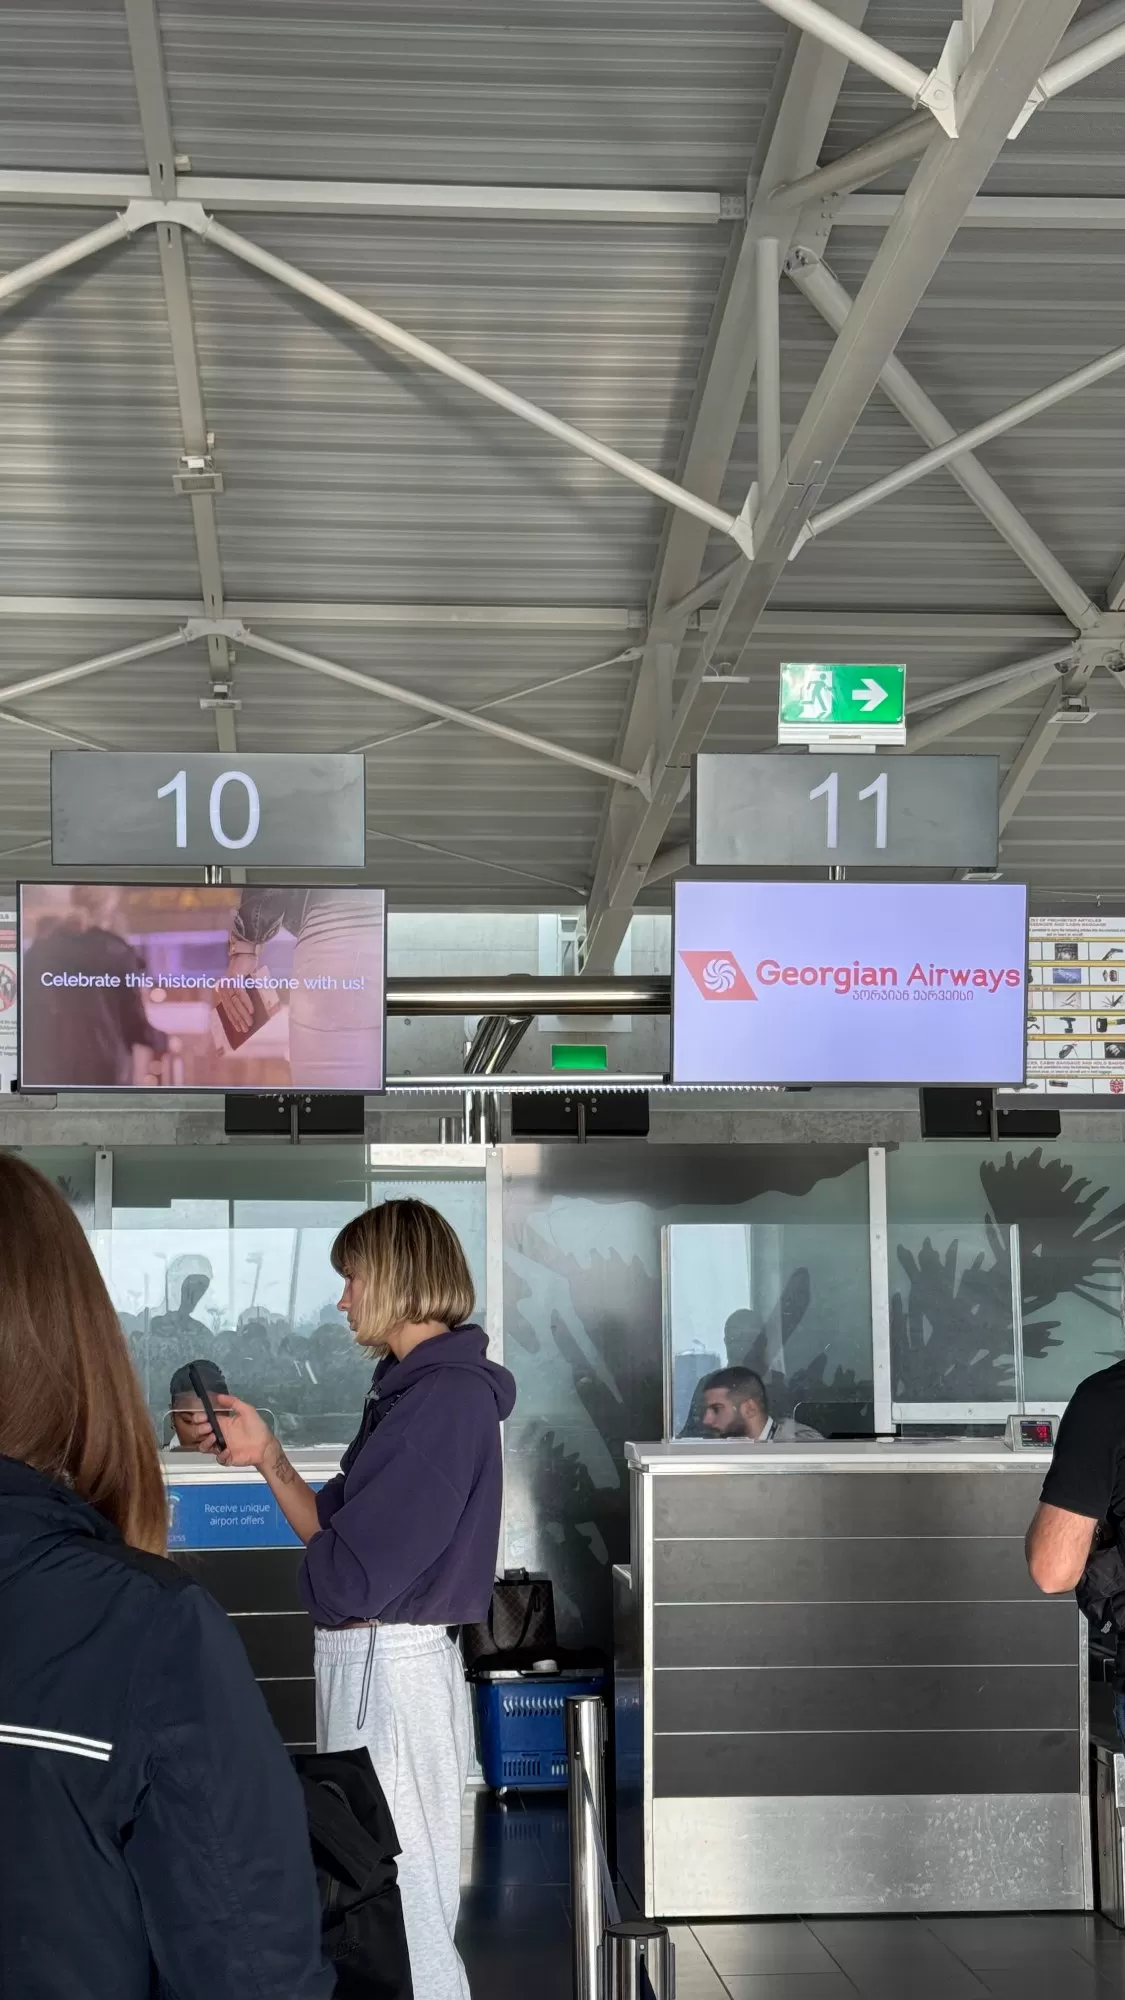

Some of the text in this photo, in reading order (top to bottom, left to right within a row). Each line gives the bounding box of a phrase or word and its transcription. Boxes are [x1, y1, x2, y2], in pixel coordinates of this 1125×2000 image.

[157, 770, 260, 849] 10
[809, 772, 888, 848] 11
[41, 972, 365, 990] Celebrate this historic milestone with us!
[756, 959, 1021, 995] Georgian Airways
[204, 1503, 271, 1514] Receive unique
[210, 1515, 265, 1527] airport offers
